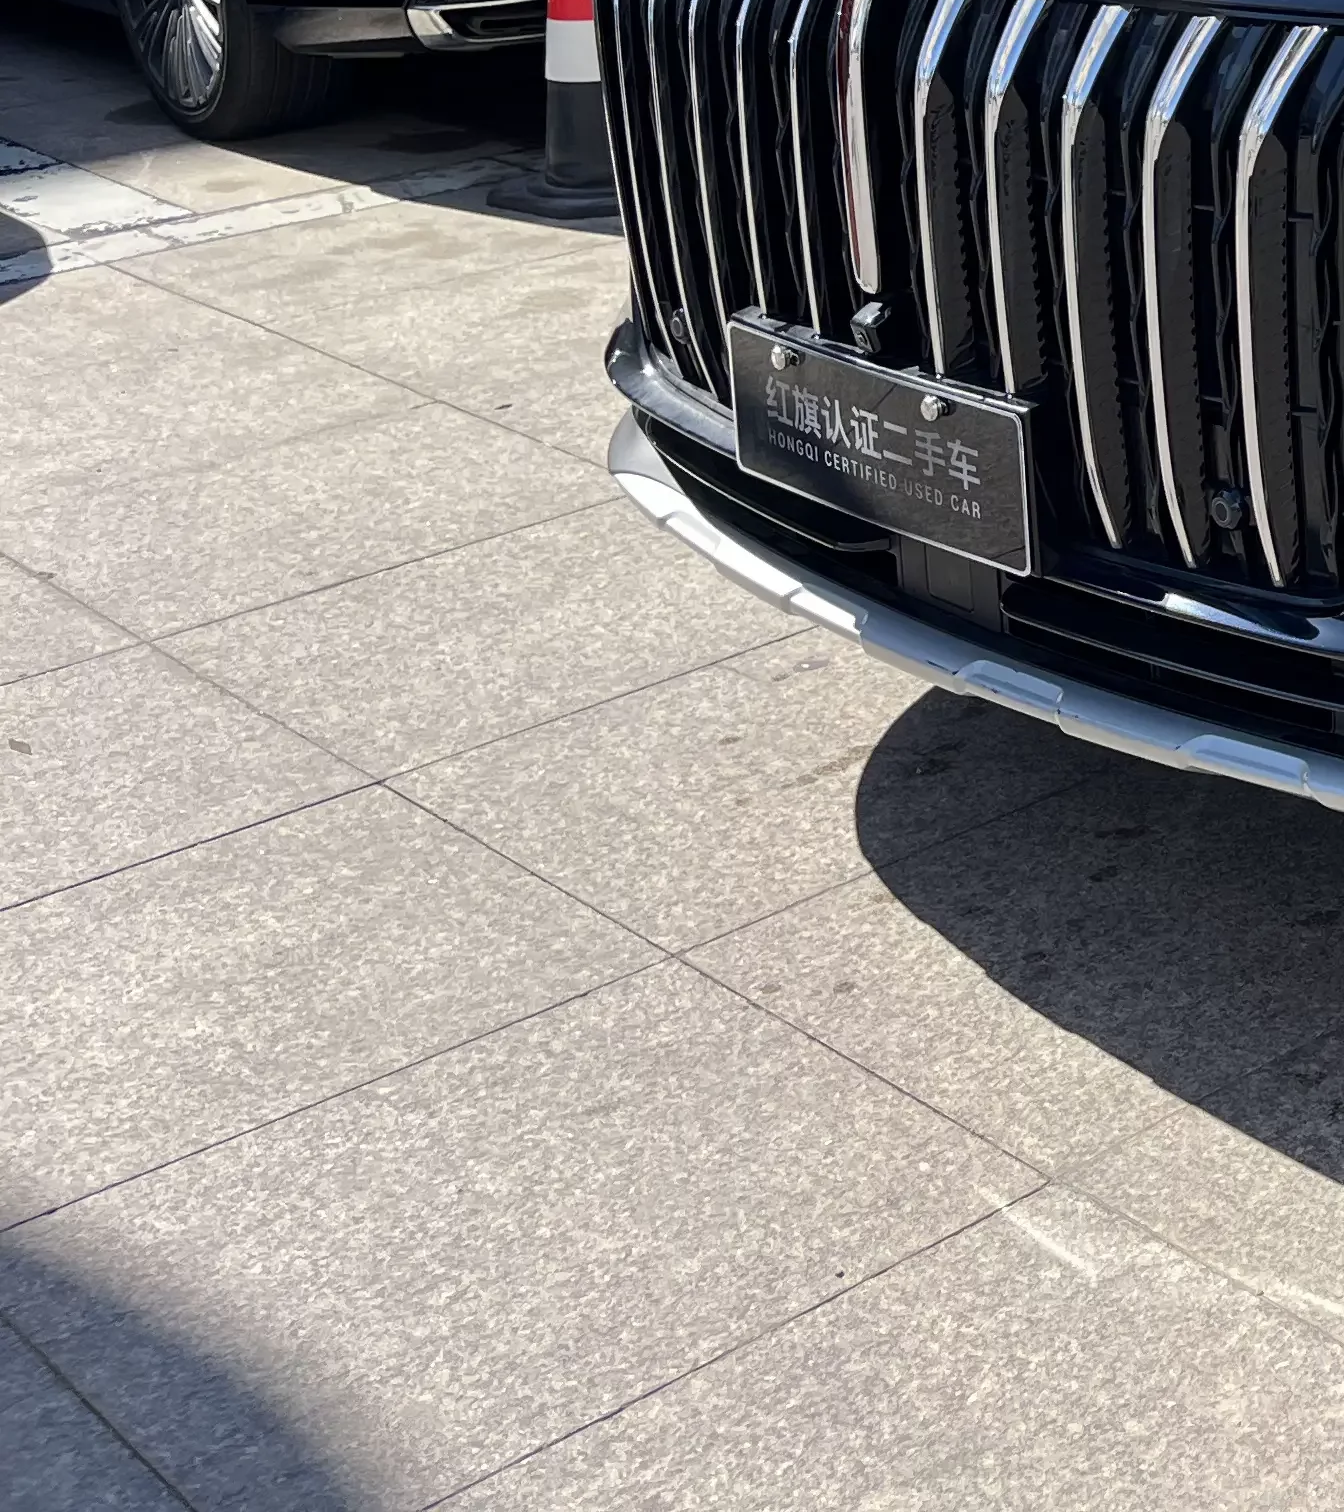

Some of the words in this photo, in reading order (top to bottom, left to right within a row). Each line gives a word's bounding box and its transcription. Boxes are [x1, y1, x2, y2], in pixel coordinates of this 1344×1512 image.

[765, 375, 982, 491] 红旗认证二手车
[767, 426, 820, 463] HONGQI
[823, 450, 898, 490] CERTIFIED
[904, 479, 944, 507] USED
[950, 494, 982, 520] CAR
